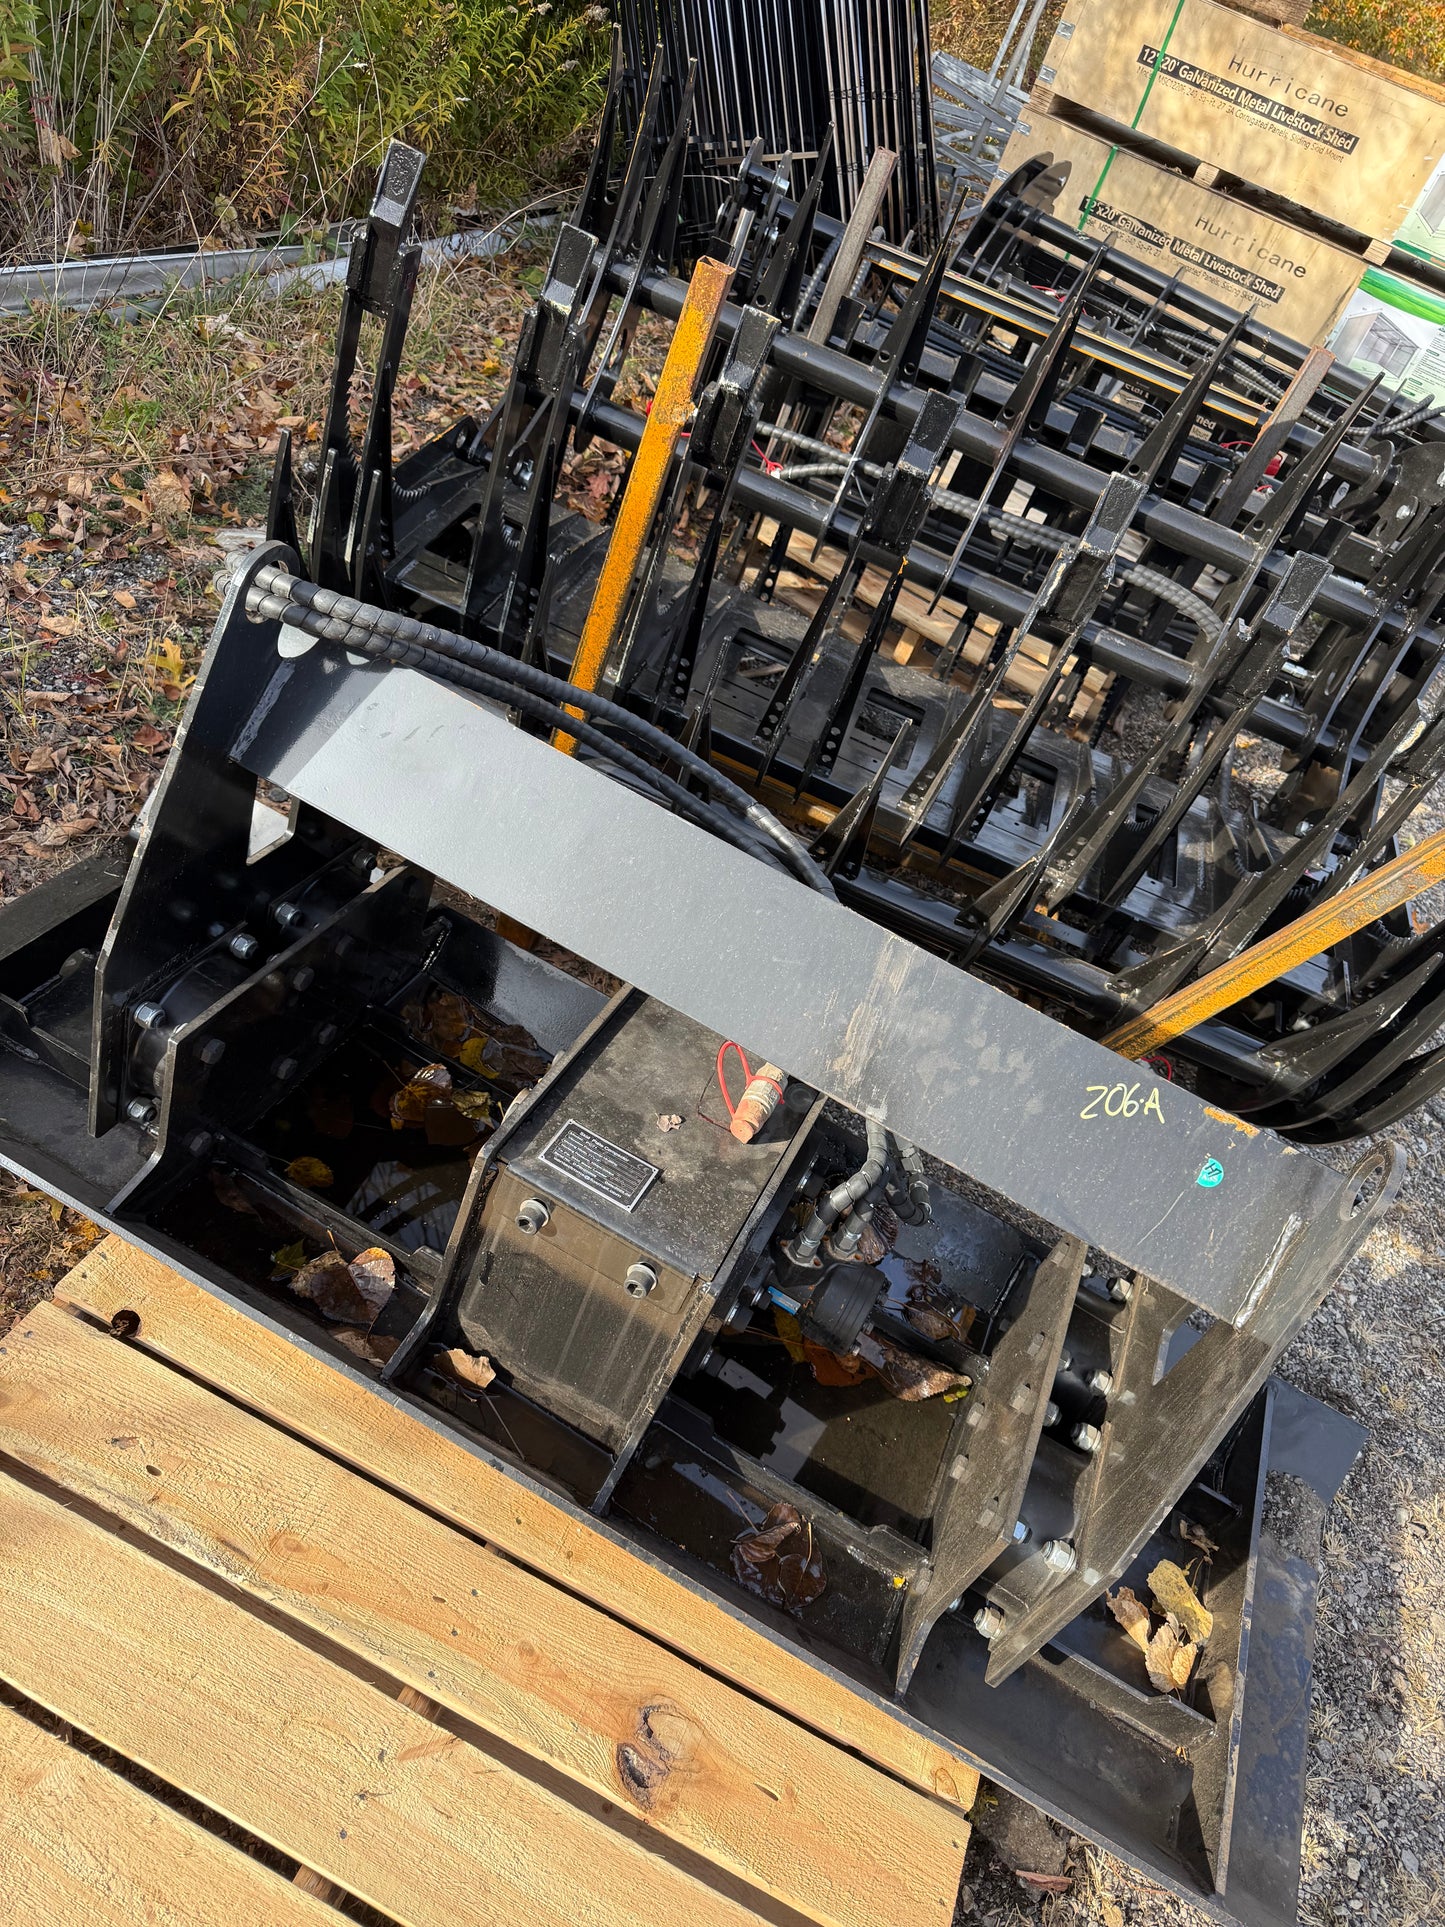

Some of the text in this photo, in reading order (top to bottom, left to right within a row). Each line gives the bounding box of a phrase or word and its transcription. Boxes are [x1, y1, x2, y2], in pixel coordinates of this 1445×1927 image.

[1178, 64, 1239, 99] Galvanized
[1236, 90, 1271, 114] Metal
[1271, 103, 1325, 137] Livestock
[1323, 127, 1354, 150] Shed
[1228, 54, 1350, 118] Hurricane
[1233, 108, 1269, 131] Corrugated
[1288, 132, 1311, 150] Sliding
[1310, 142, 1325, 155] Skid
[1323, 147, 1345, 163] Mount
[1116, 213, 1173, 248] Galvanized
[1171, 239, 1204, 263] Metal
[1202, 254, 1253, 286] Livestock
[1251, 276, 1281, 299] Shed
[1194, 215, 1307, 278] Hurricane
[1240, 290, 1253, 301] Skid
[1252, 296, 1272, 310] Mount
